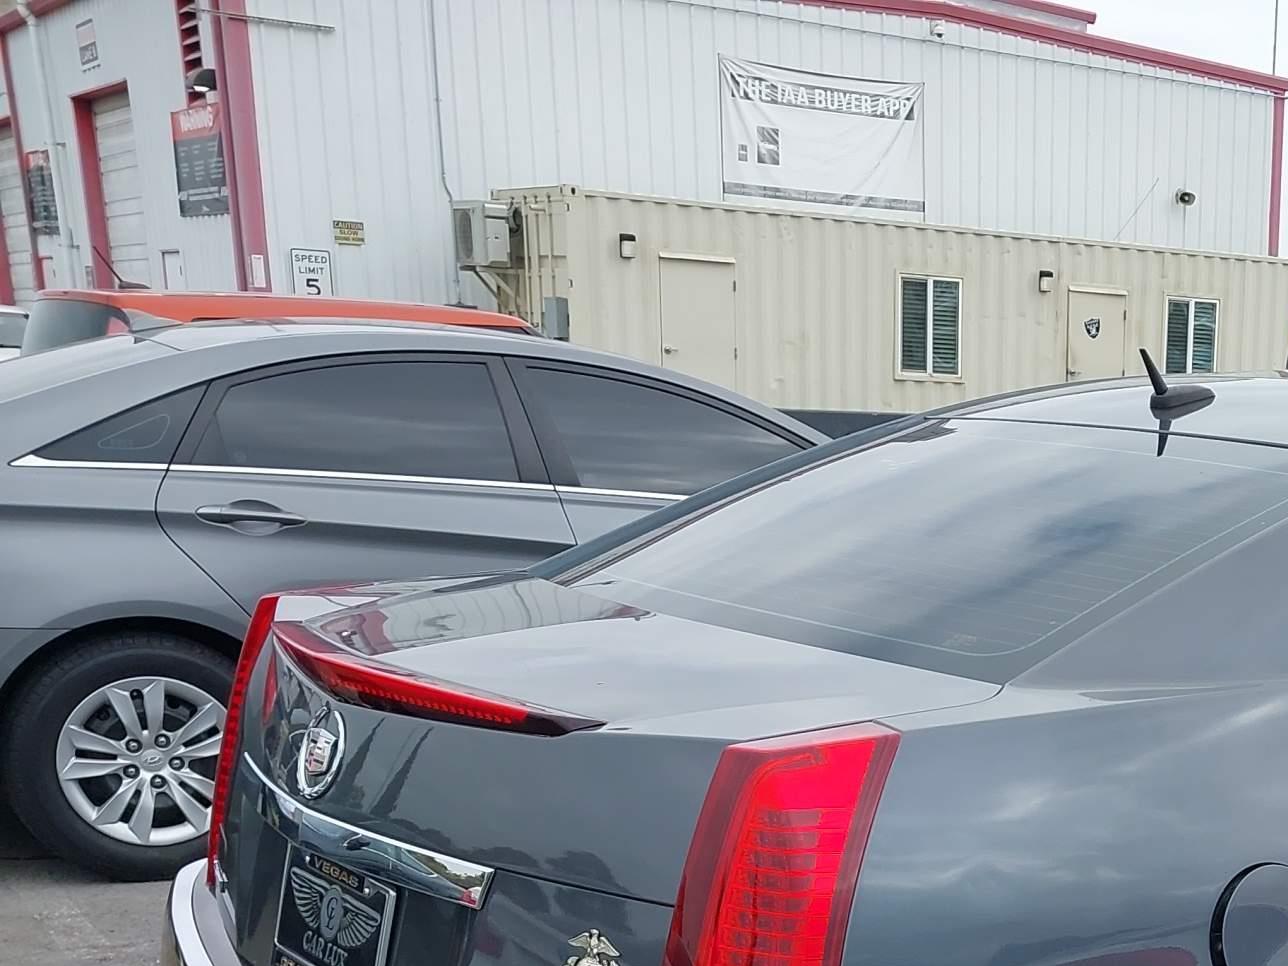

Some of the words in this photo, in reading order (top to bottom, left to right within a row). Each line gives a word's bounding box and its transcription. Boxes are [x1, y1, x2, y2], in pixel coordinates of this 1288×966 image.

[736, 77, 771, 101] THE
[776, 84, 810, 105] IAA
[815, 89, 872, 114] BUYER
[876, 98, 912, 117] APP
[294, 254, 328, 264] SPEED
[298, 265, 325, 275] LIMIT
[306, 278, 321, 295] 5
[313, 855, 360, 888] VEGAS
[302, 930, 324, 960] CAR
